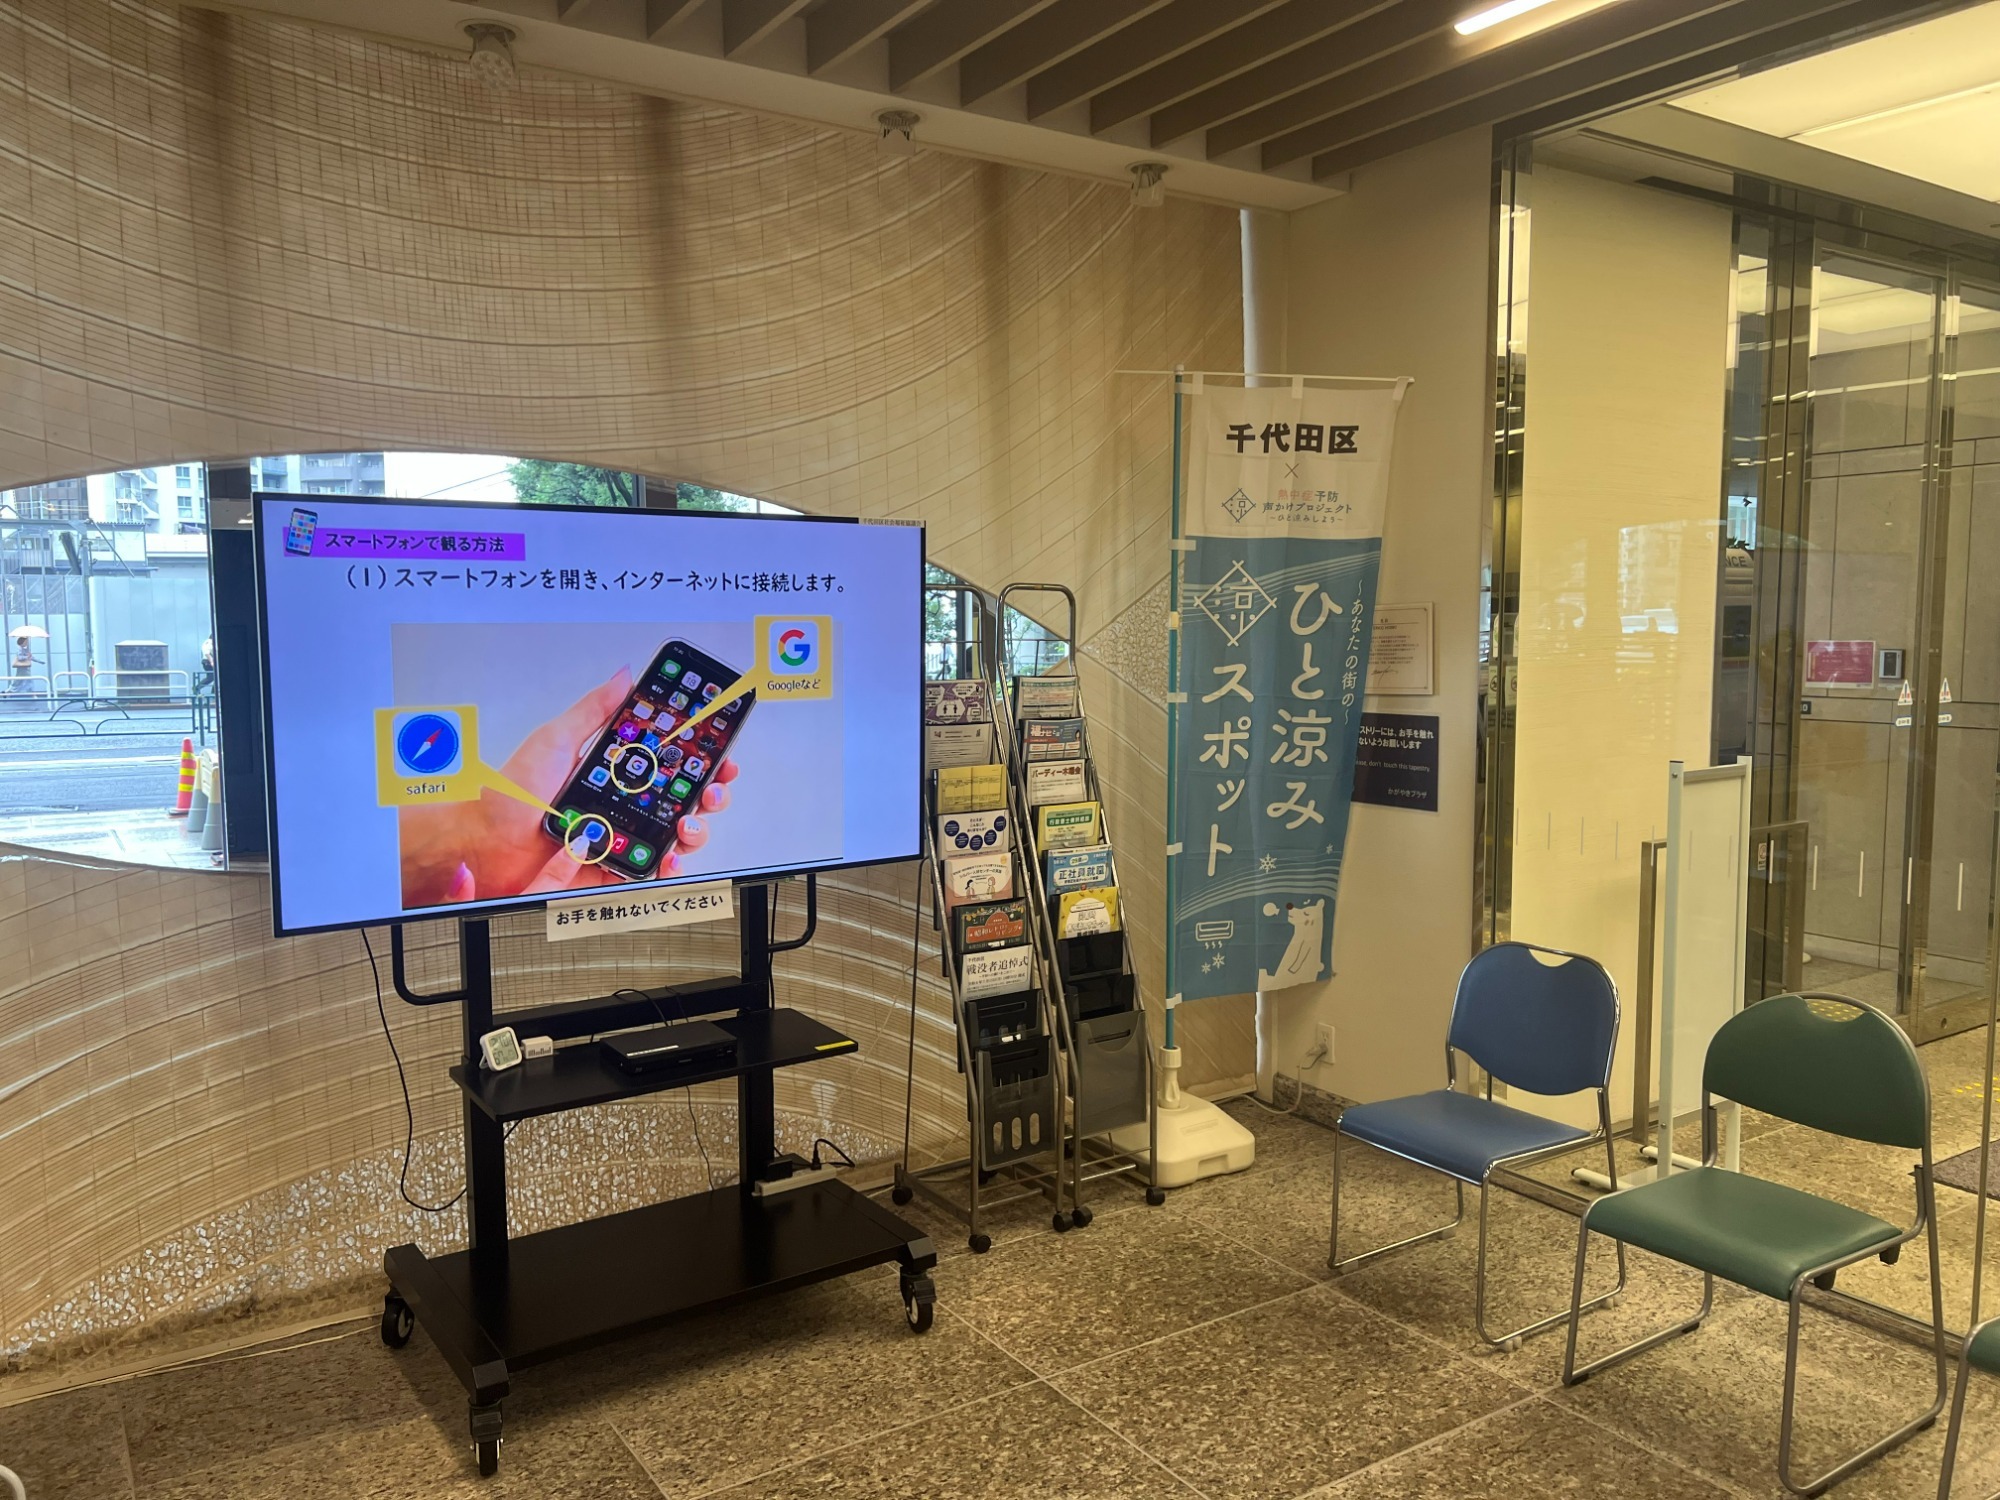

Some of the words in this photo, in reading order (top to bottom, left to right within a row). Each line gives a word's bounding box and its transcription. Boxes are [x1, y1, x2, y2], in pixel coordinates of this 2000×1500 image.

[1226, 423, 1359, 454] 千代田区
[1278, 489, 1339, 502] 熱中症予防
[1262, 502, 1352, 514] 声かけプロジェクト
[325, 533, 505, 553] スマートフォンで観る方法
[767, 678, 821, 693] Googleなど
[1266, 582, 1343, 830] ひと涼み
[1359, 737, 1422, 749] ないようお願いします
[1199, 662, 1255, 877] スポット
[406, 781, 445, 795] safari
[556, 895, 723, 926] お手を触れないでください
[967, 956, 1028, 975] 戦没者追悼式
